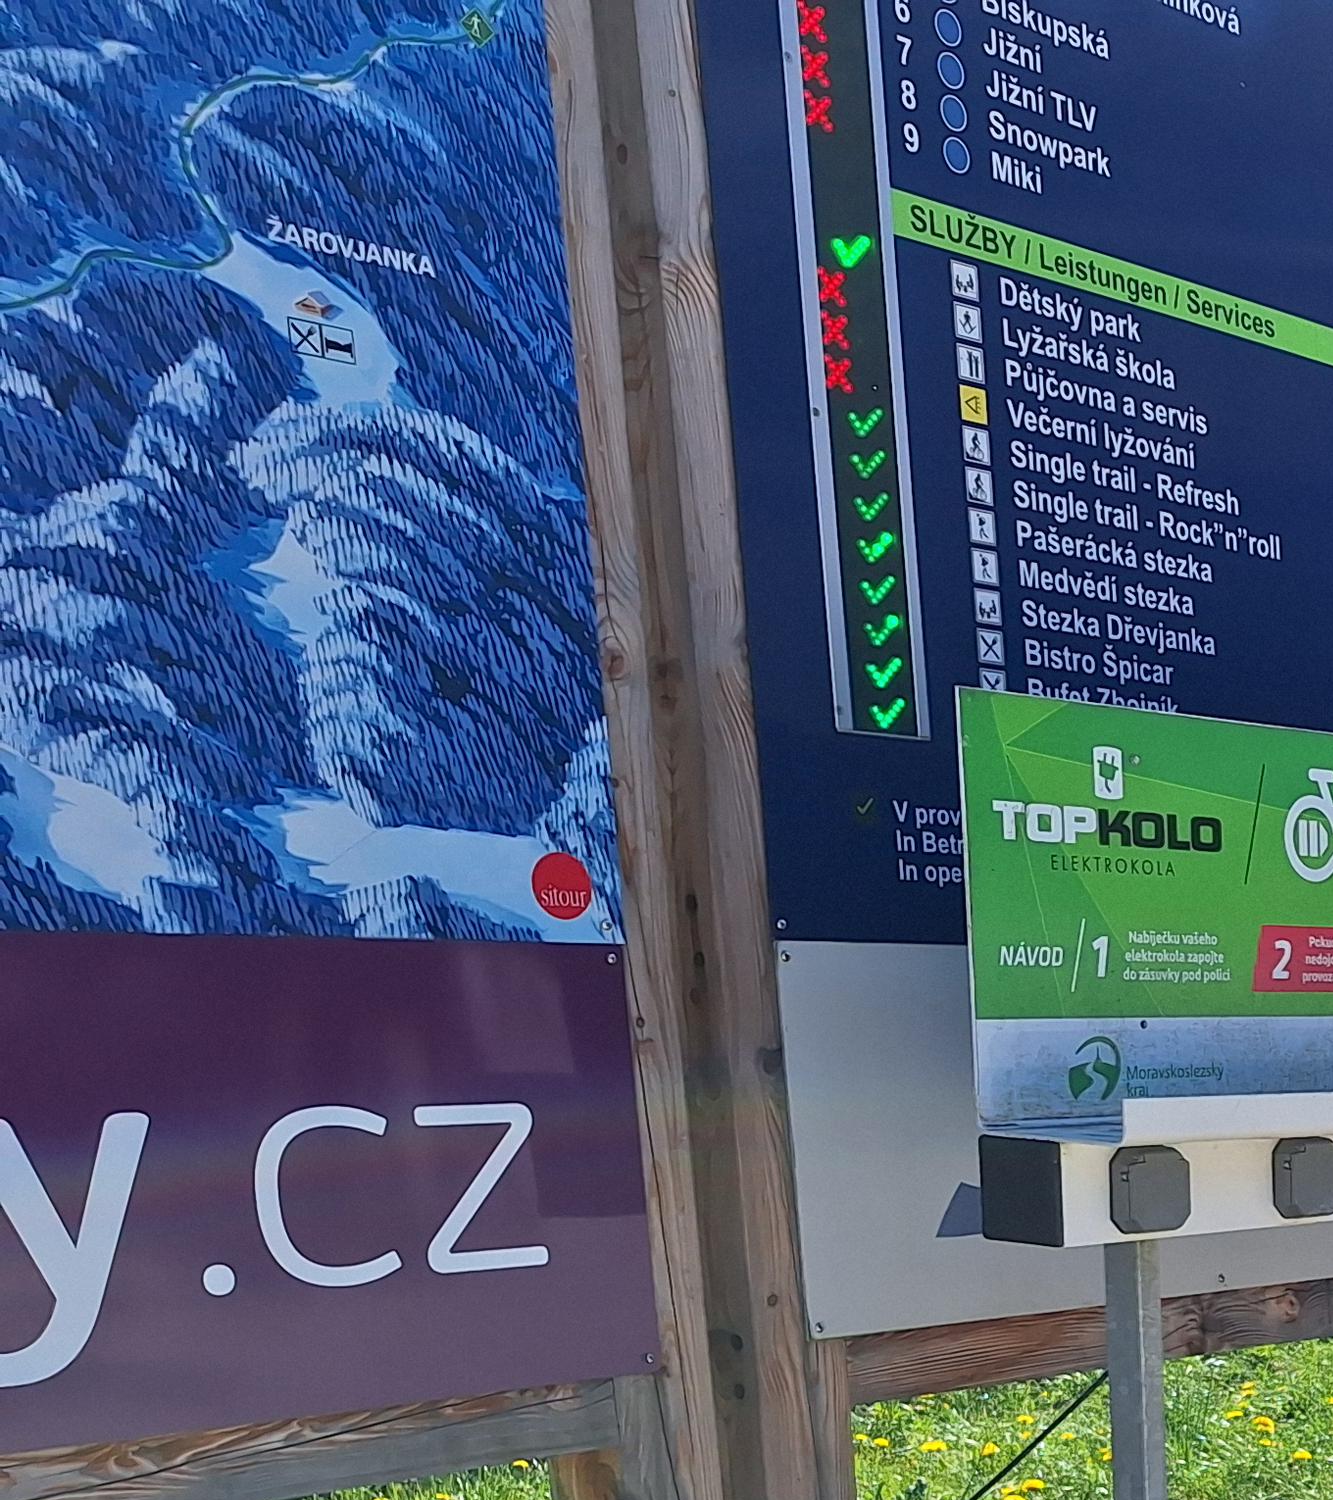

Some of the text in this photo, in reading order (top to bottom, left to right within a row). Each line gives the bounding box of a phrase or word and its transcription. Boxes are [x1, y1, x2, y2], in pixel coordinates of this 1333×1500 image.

[894, 0, 1042, 74] 6 Jižní
[896, 35, 1097, 132] 7 Jižní TLV
[901, 80, 1111, 178] 8 Snowpark
[904, 122, 1042, 195] 9 Miki
[266, 214, 437, 278] ŽAROVJANKA
[909, 203, 1016, 260] SLUŽBY
[1039, 243, 1167, 306] Leistungen
[1186, 289, 1276, 339] Services
[999, 276, 1142, 343] Dětský park
[1001, 317, 1176, 390] Lyžařská škola
[1004, 358, 1208, 435] Půjčovna a servis
[1006, 398, 1195, 469] Večerní lyžování
[1010, 440, 1086, 484] Single
[1092, 460, 1136, 493] trail
[1156, 473, 1240, 516] Refresh
[1012, 480, 1089, 523] Single
[1095, 499, 1139, 532] trail
[1016, 520, 1213, 583] Pašerácká stezka
[1019, 560, 1195, 616] Medvědí stezka
[1021, 600, 1216, 657] Stezka Dřevjanka
[1024, 638, 1174, 685] Bistro Špicar
[893, 800, 908, 822] V
[992, 800, 1223, 853] TOPKOLO
[896, 829, 916, 852] In
[1051, 854, 1176, 877] ELEKTROKOLA
[541, 884, 587, 908] sitour
[899, 858, 918, 881] In
[1000, 941, 1064, 967] NÁVOD
[1092, 935, 1109, 978] 1
[1125, 950, 1224, 966] elektrokola zapojte
[1182, 932, 1217, 946] vašeho
[1272, 939, 1292, 979] 2
[1123, 967, 1136, 981] do
[1139, 967, 1179, 983] zásuvky
[1182, 968, 1201, 983] pod
[1126, 1061, 1224, 1081] Moravskoslezský
